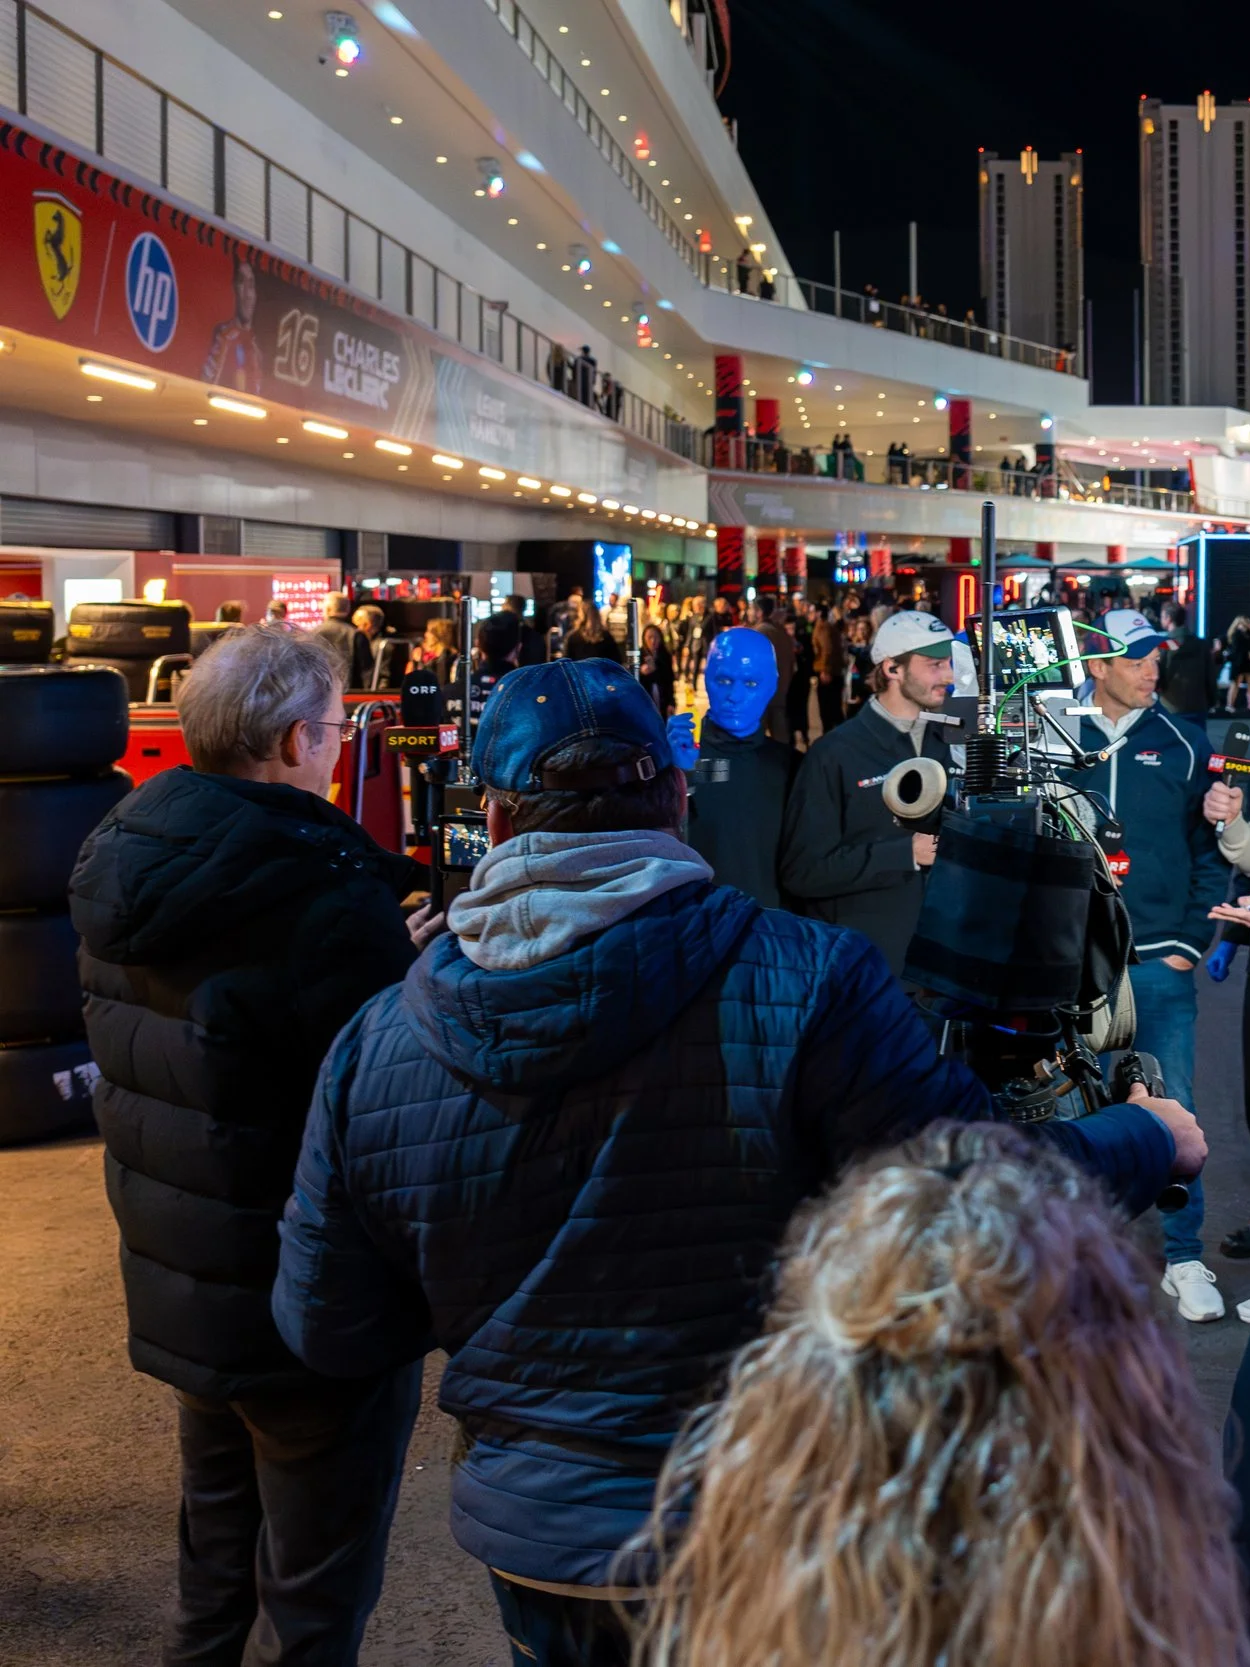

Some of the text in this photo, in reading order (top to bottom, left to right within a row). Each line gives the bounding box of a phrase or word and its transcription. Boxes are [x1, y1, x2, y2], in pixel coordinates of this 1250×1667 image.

[133, 234, 173, 347] hp
[274, 308, 319, 387] 16
[333, 330, 400, 384] CHARLES
[323, 358, 389, 412] LECLERC
[409, 685, 438, 695] ORF
[388, 729, 458, 747] SPORT ORF
[1108, 861, 1129, 872] RF
